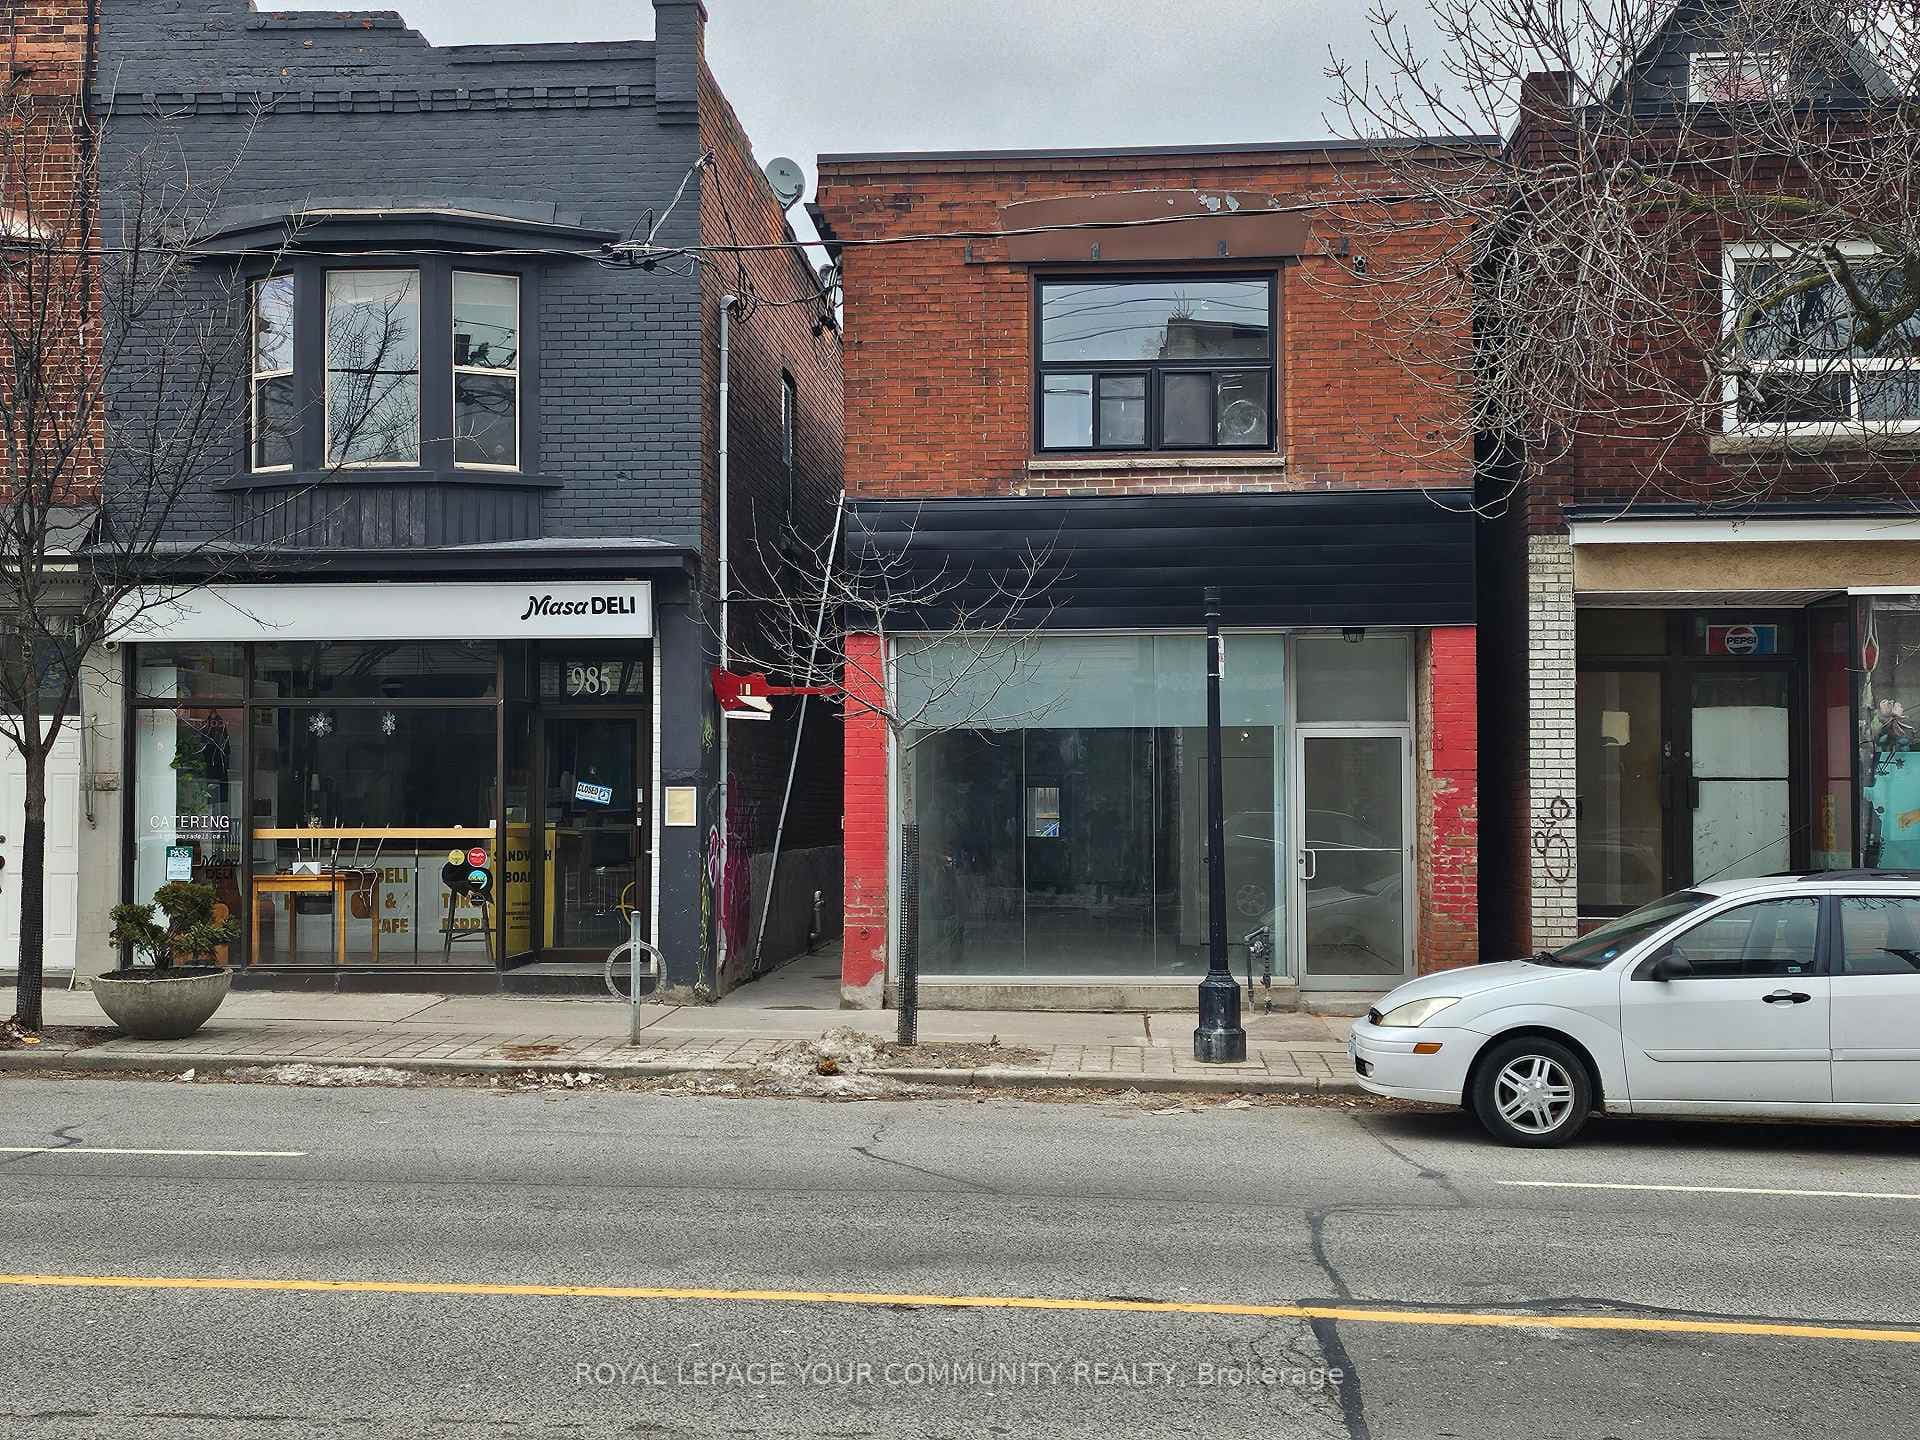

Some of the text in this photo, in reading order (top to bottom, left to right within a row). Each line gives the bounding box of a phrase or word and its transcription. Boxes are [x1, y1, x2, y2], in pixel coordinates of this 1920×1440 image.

[521, 595, 635, 620] Masa DELI
[1727, 636, 1757, 645] PEPSI
[571, 666, 611, 696] 985
[578, 784, 599, 796] CLOSED
[149, 815, 230, 828] CATERING
[170, 849, 189, 858] PASS
[379, 918, 408, 934] AFE
